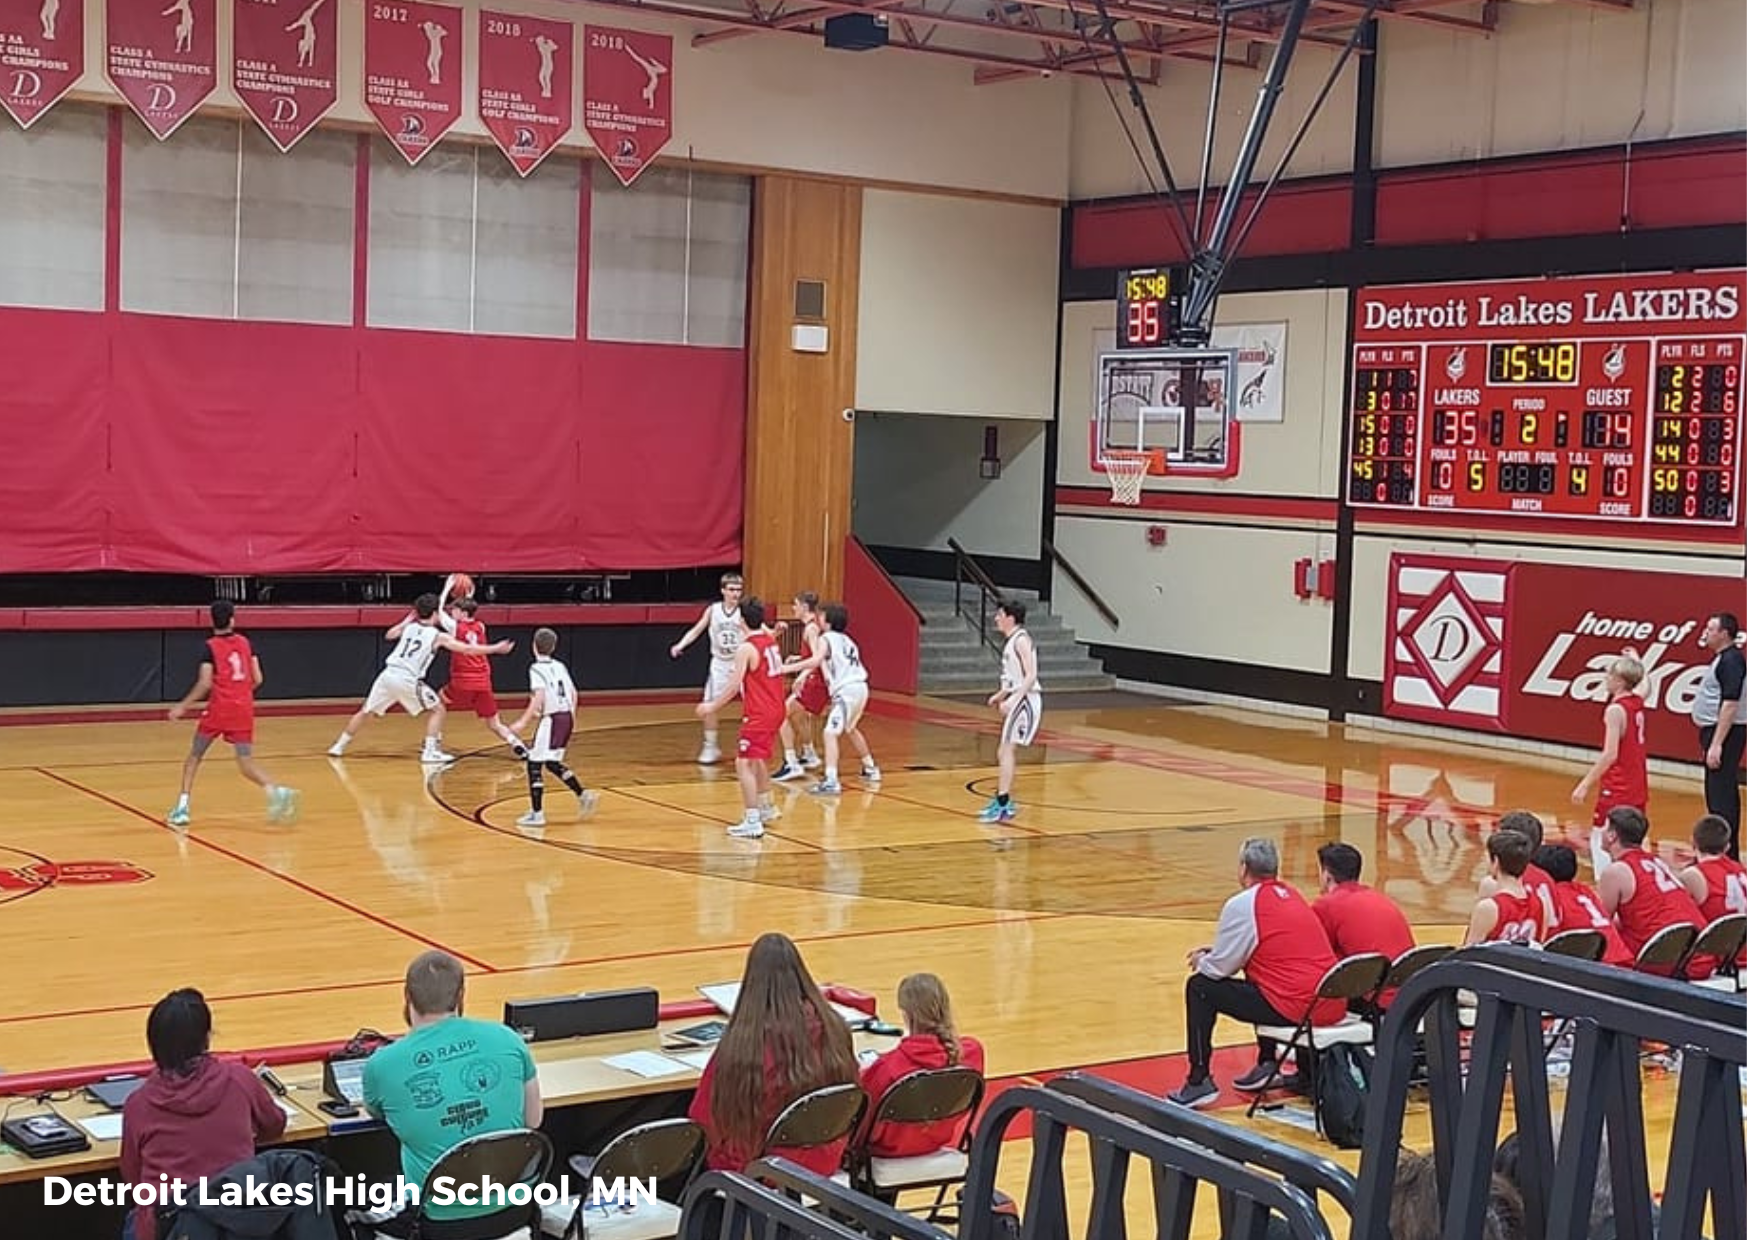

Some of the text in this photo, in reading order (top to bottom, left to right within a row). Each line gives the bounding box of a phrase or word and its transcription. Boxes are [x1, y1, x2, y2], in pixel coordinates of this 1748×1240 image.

[373, 5, 408, 21] 2017
[487, 20, 521, 36] 2018
[591, 33, 624, 49] 2018
[1125, 276, 1167, 300] 15:48
[1364, 285, 1740, 329] Detroit Lakes LAKERS
[1128, 301, 1159, 342] 35
[1502, 345, 1574, 381] 15:48
[1672, 366, 1737, 388] 2 2 0
[1367, 391, 1417, 410] 3 0 17
[1434, 389, 1480, 406] LAKERS
[1513, 398, 1545, 411] PERIOD
[1586, 389, 1632, 406] GUEST
[1664, 391, 1735, 413] 12 2 6
[1359, 414, 1415, 435] 15 0 0
[1444, 411, 1477, 445] 35
[1521, 414, 1537, 443] 2
[1604, 414, 1631, 446] 14
[1662, 417, 1734, 440] 14 0 3
[1358, 436, 1414, 456] 13 0 0
[1430, 449, 1457, 462] FOULS
[1497, 450, 1558, 464] PLAYER FOUL
[1655, 442, 1732, 466] 44 0 0
[1353, 459, 1373, 479] 45
[1402, 463, 1413, 479] 4
[1603, 453, 1634, 466] FOULS
[1439, 462, 1452, 490] 0
[1470, 463, 1484, 491] 5
[1571, 467, 1586, 493] 4
[1613, 468, 1627, 497] 0
[1654, 469, 1731, 493] 50 0 3
[1376, 482, 1387, 502] 0
[1427, 494, 1454, 508] SCORE
[1511, 498, 1543, 511] MATCH
[1600, 502, 1632, 516] SCORE
[1685, 495, 1696, 518] 0
[1429, 614, 1470, 662] D
[1575, 611, 1653, 640] home
[1657, 620, 1696, 645] of
[400, 638, 423, 659] 12
[228, 650, 247, 682] 1
[437, 1040, 478, 1058] RAPP
